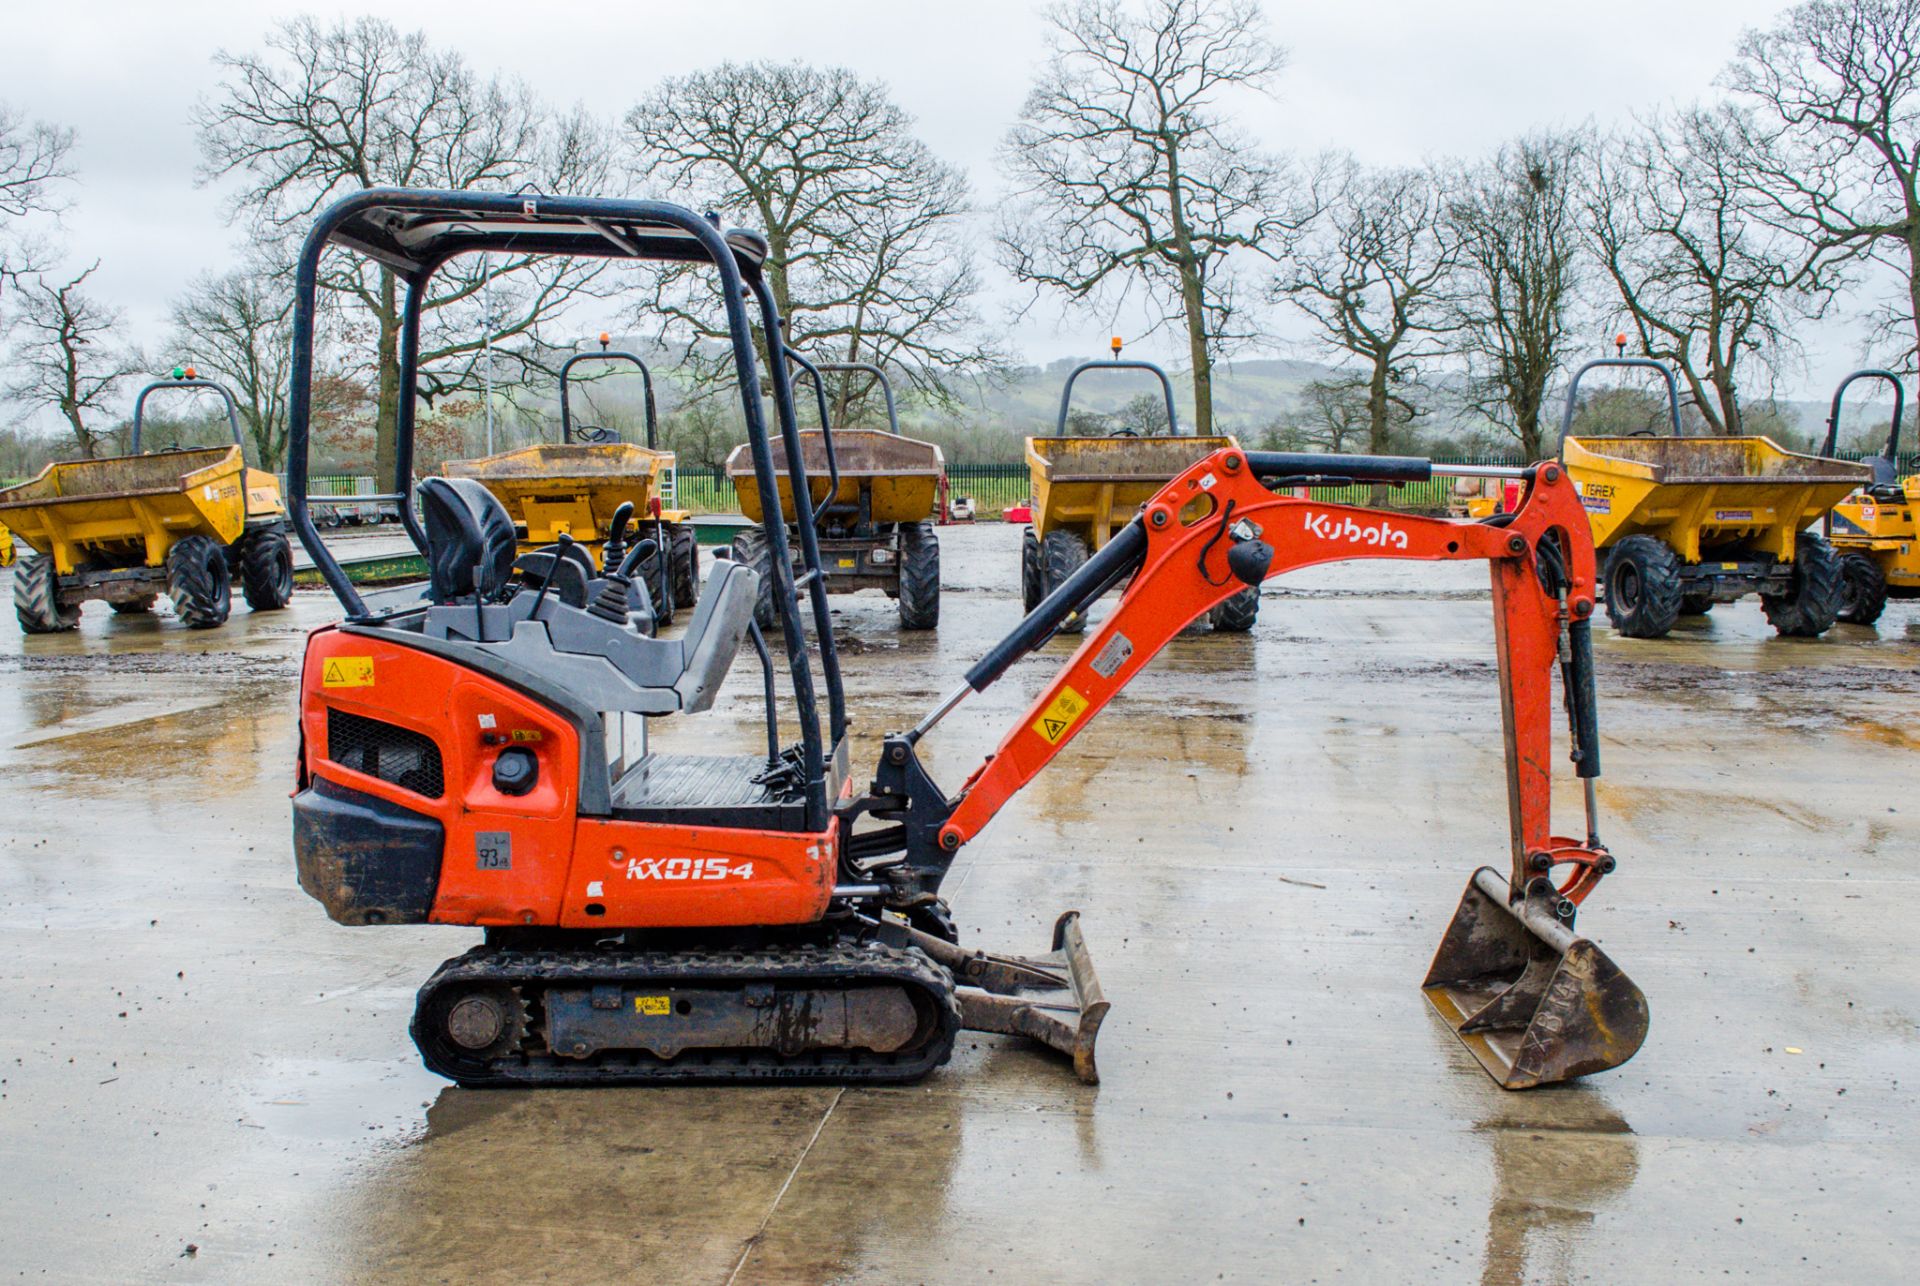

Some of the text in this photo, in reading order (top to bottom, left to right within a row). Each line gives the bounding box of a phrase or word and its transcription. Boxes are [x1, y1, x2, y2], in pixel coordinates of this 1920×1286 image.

[1585, 483, 1616, 498] TEREX
[1304, 512, 1408, 549] Kubota
[479, 848, 498, 867] 93
[626, 858, 753, 880] KX015-4
